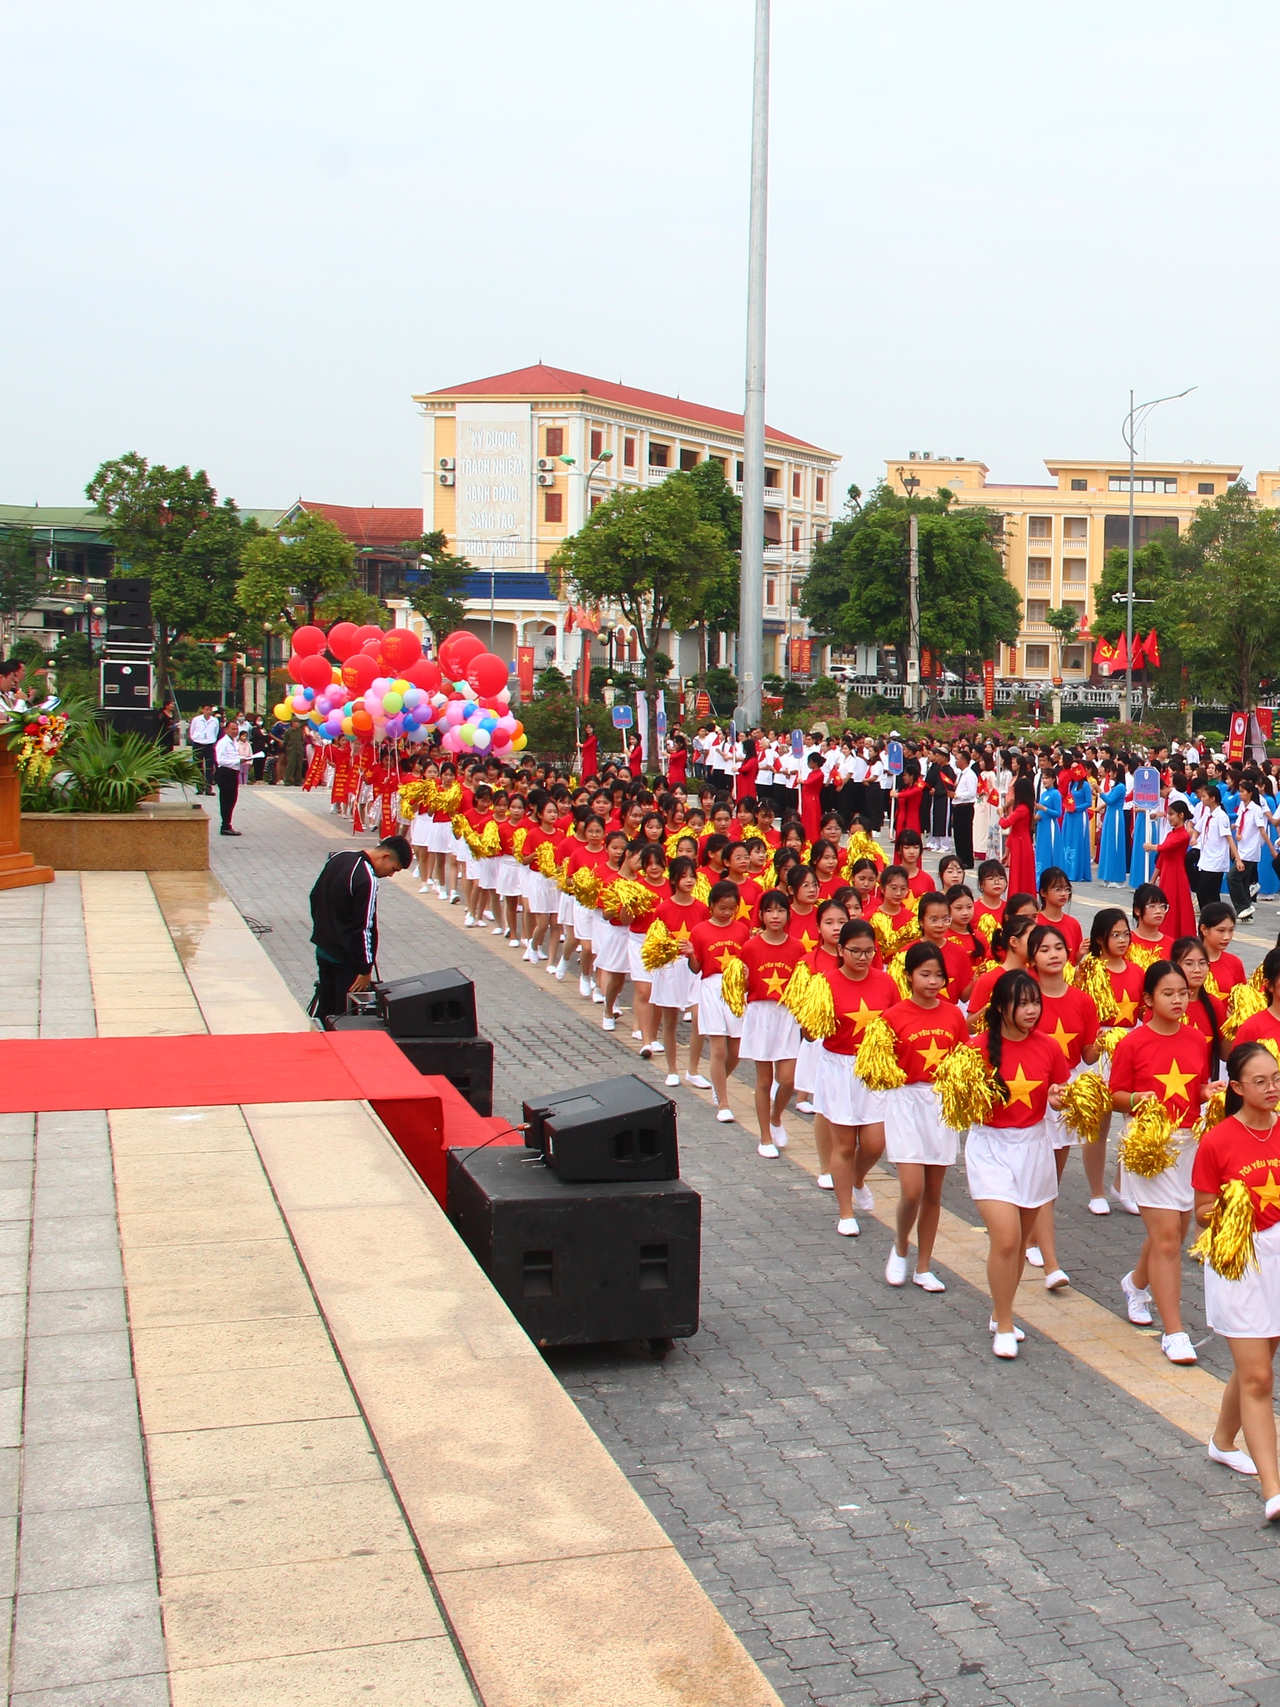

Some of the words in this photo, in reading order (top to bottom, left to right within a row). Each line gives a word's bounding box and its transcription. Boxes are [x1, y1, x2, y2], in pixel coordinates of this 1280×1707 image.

[462, 456, 492, 474] TRÁCH
[466, 483, 490, 502] HÀNH
[470, 512, 495, 529] SÁNG
[1239, 1166, 1252, 1177] TÔI
[1251, 1159, 1266, 1169] YÊU
